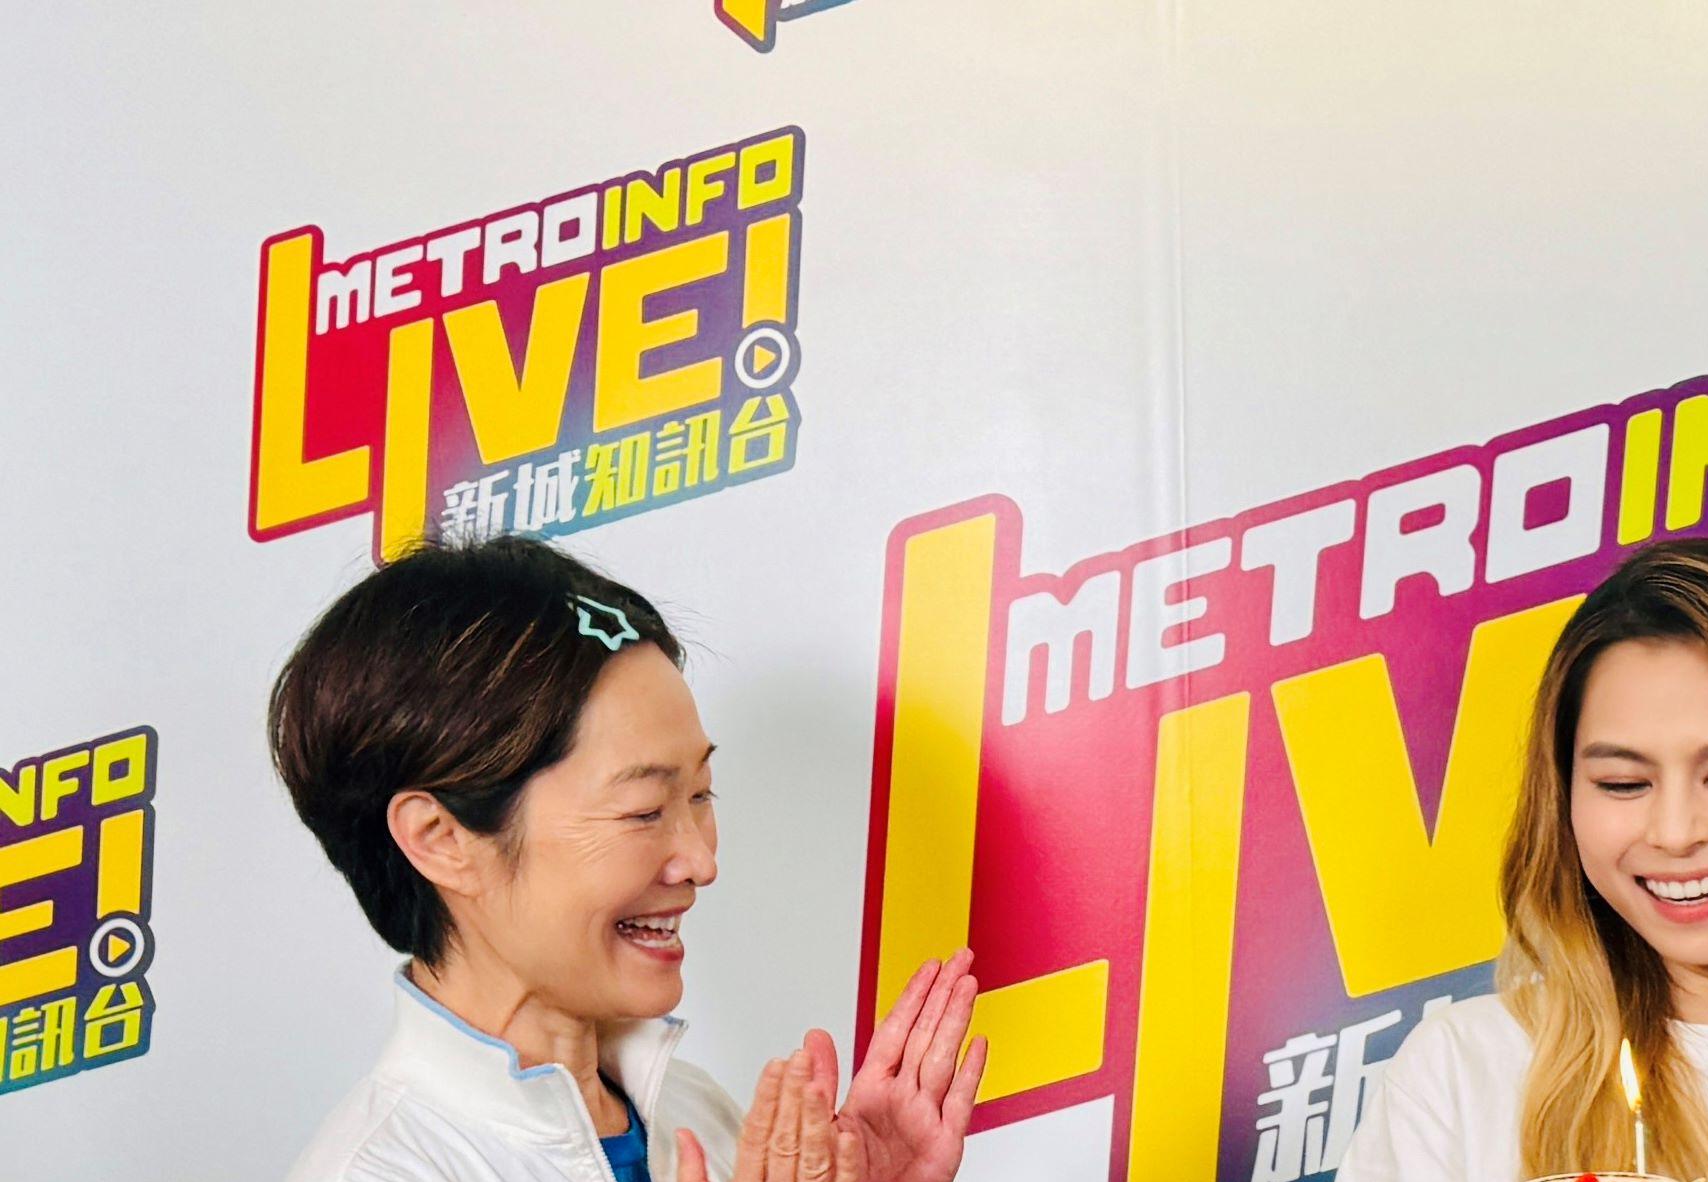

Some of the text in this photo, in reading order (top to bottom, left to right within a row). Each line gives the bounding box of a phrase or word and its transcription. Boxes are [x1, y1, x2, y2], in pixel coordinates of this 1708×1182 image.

[255, 213, 791, 564] LIVE!
[441, 396, 786, 550] 新城知訊台
[0, 982, 143, 1081] 訊台
